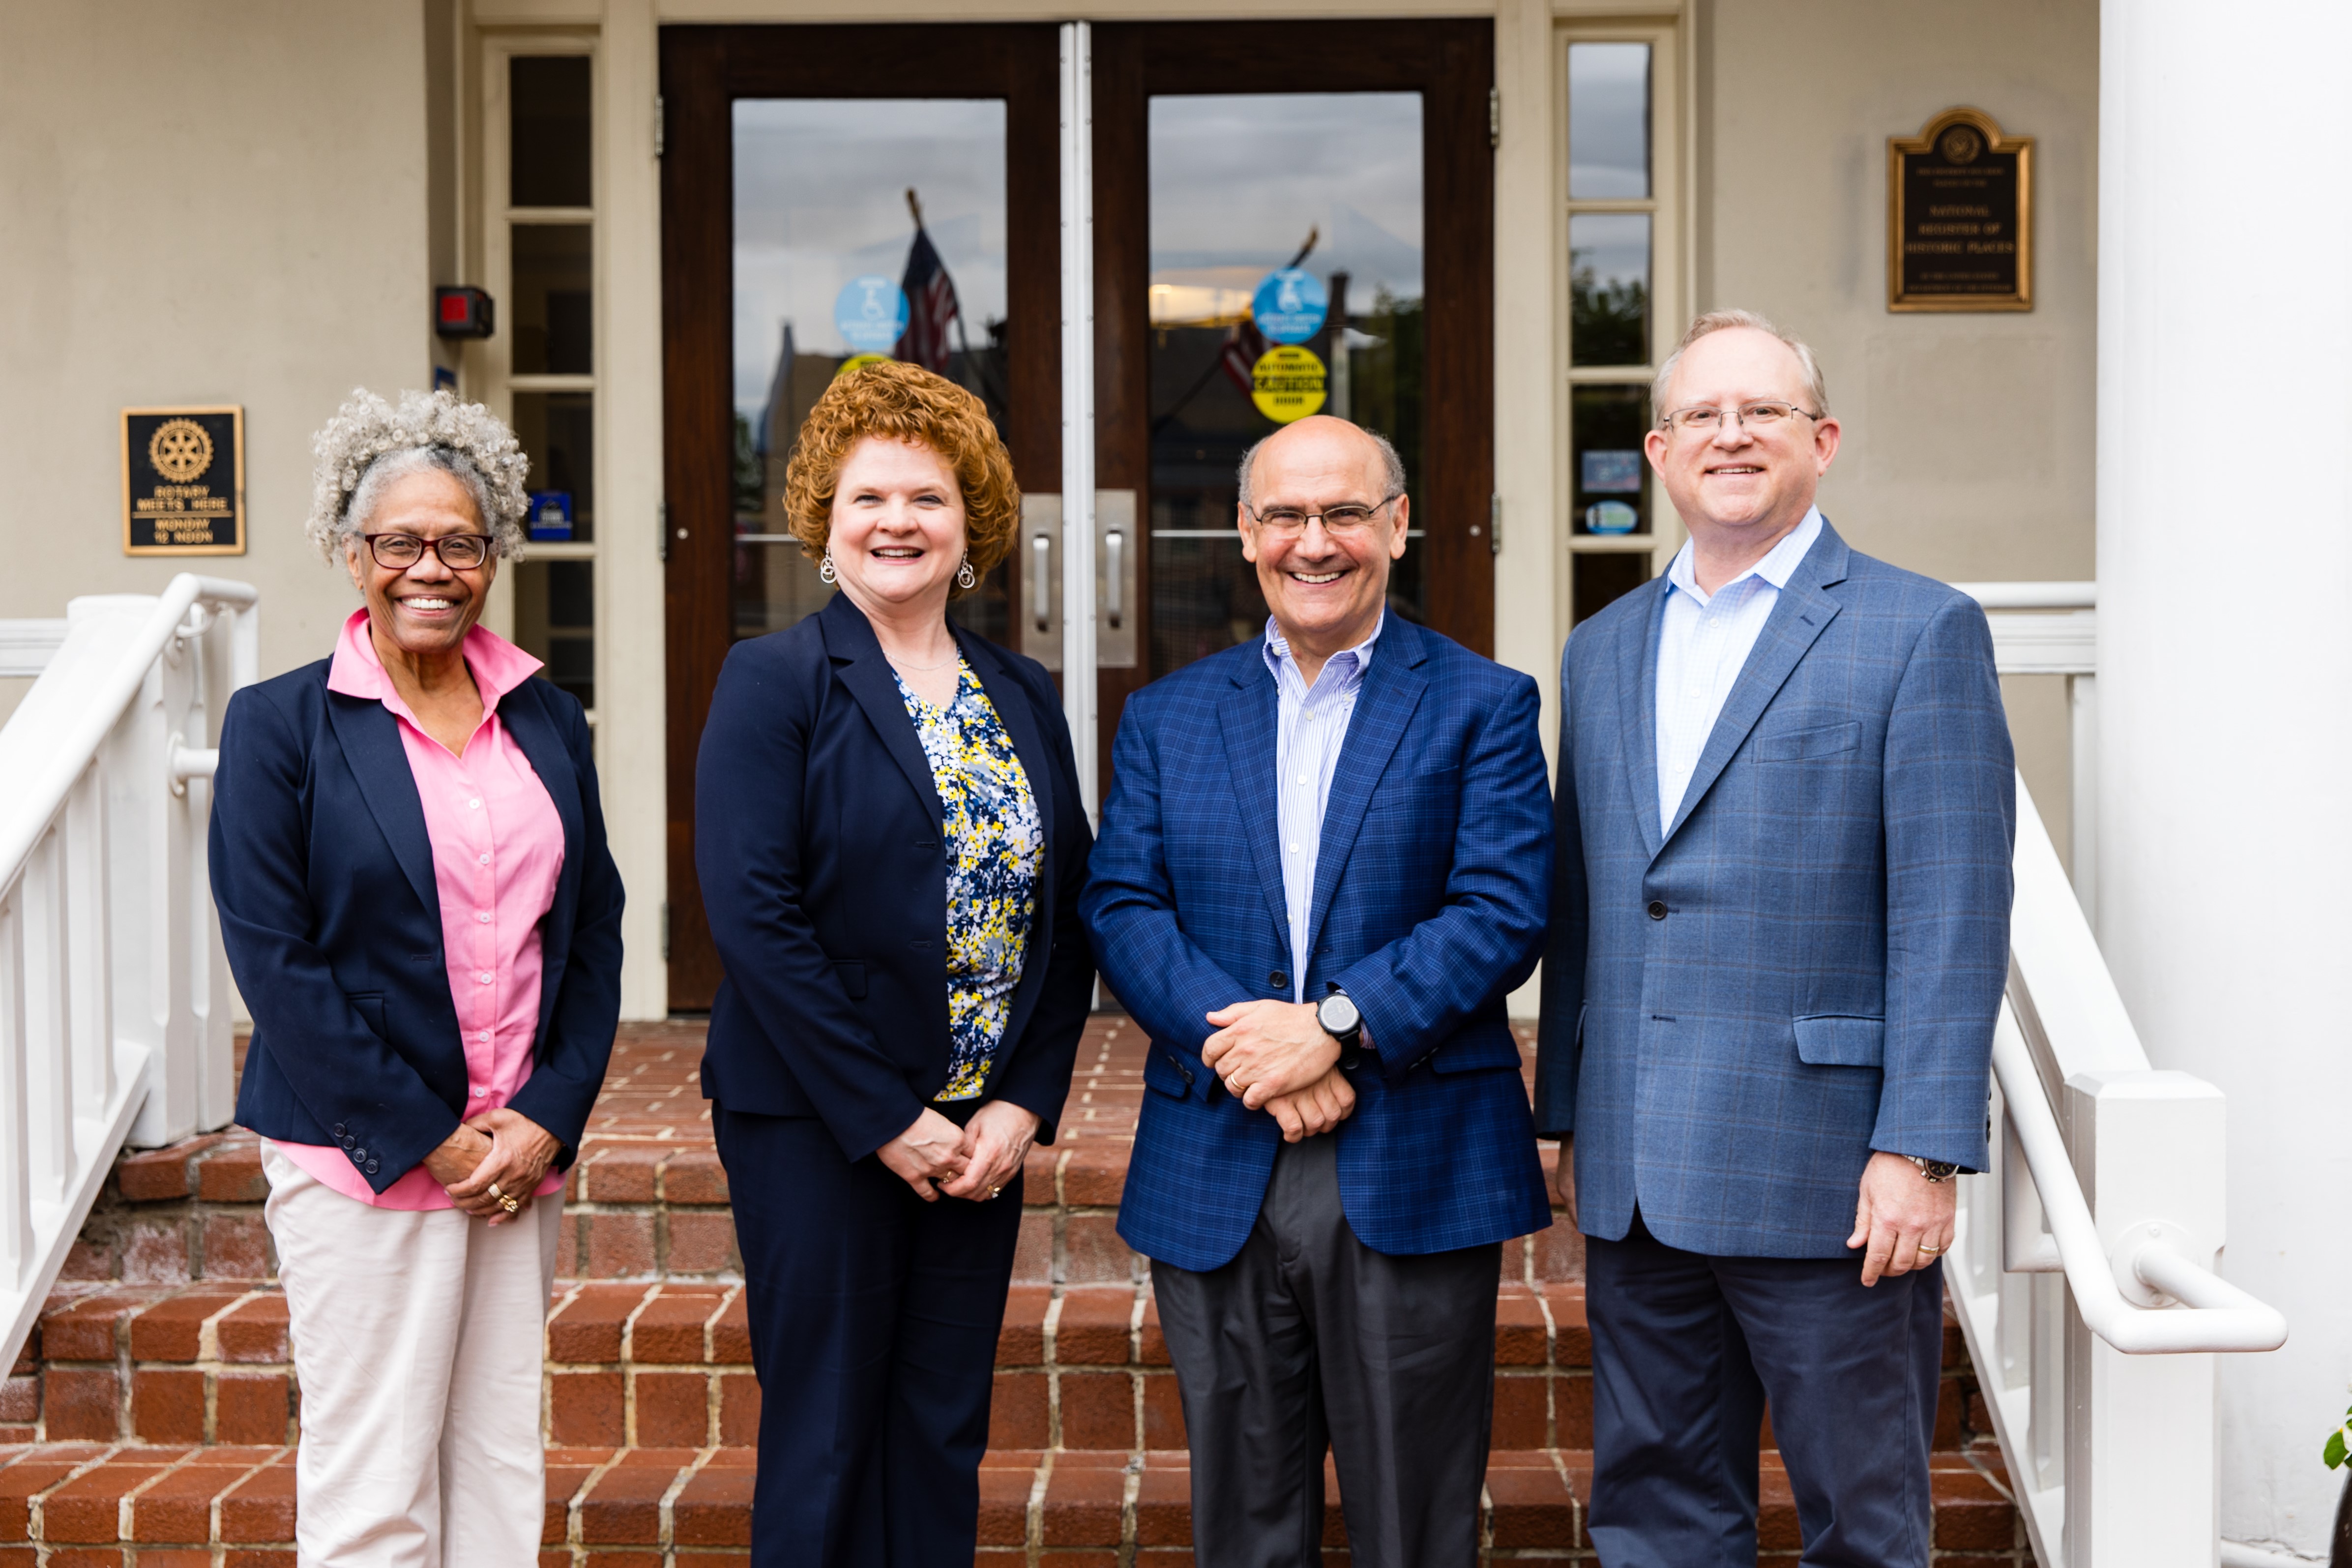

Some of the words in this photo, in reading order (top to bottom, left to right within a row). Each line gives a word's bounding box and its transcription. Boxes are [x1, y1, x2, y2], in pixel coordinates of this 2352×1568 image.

[1930, 205, 1991, 217] NATIONAL
[1918, 223, 1980, 235] REGISTER
[1983, 223, 2002, 235] OF
[1906, 240, 1964, 254] HISTORIC
[1967, 240, 2014, 254] PLACES
[154, 486, 209, 499] ROTARY
[137, 499, 184, 511] MEETS
[192, 498, 228, 511] HERE
[155, 519, 210, 531] MONDAY
[154, 531, 169, 543] 12
[174, 531, 213, 542] NOON
